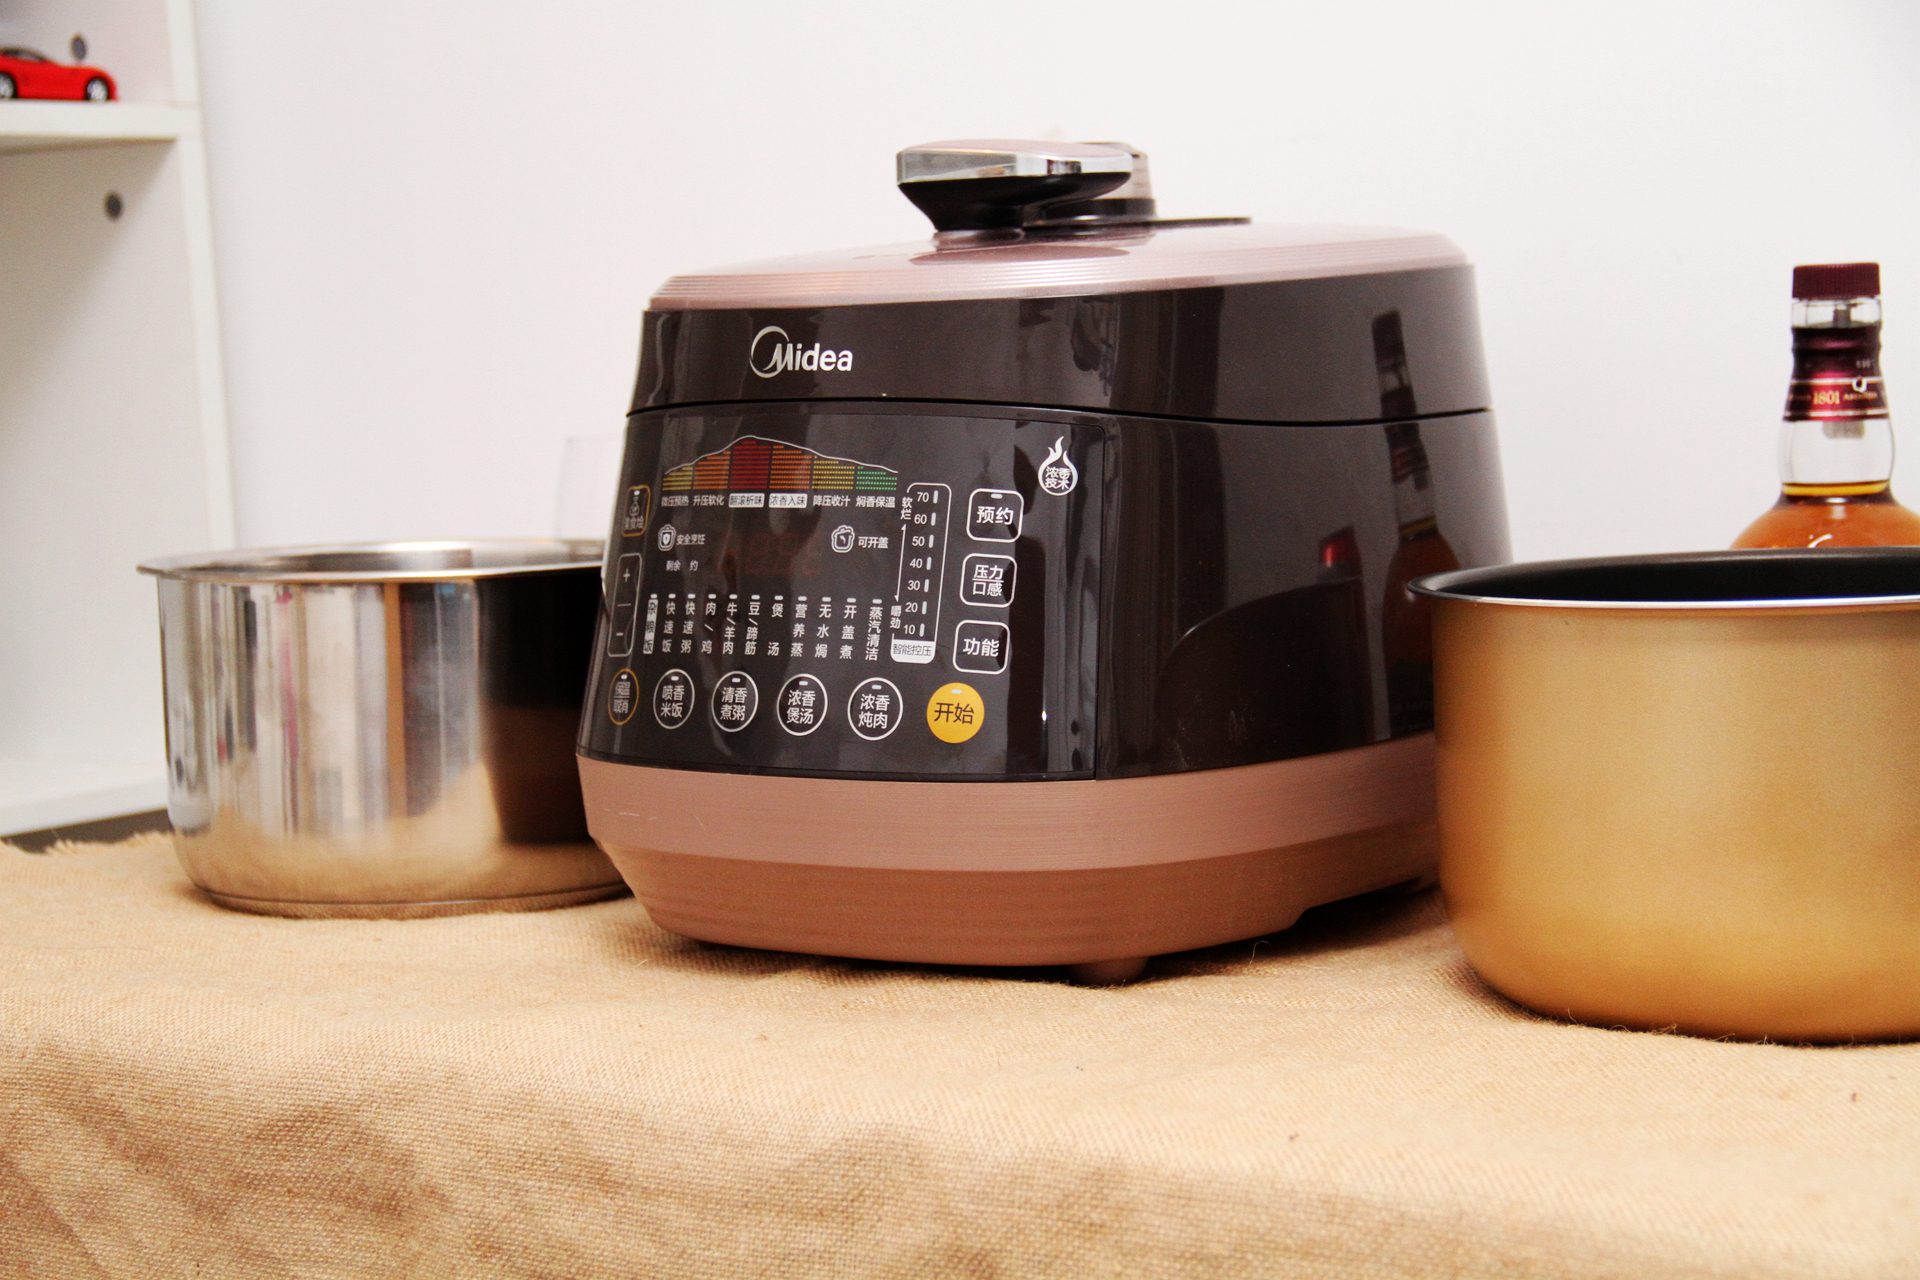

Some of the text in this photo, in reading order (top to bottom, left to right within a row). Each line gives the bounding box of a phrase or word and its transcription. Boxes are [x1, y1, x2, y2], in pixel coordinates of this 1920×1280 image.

[749, 325, 853, 378] Midea
[1813, 389, 1840, 405] 1801
[1045, 477, 1070, 490] 技术
[693, 494, 725, 507] 升压软化
[769, 494, 806, 507] 浓香入味
[812, 495, 850, 507] 降压收汁
[855, 496, 896, 508] 焖香保温
[916, 492, 930, 503] 70
[914, 514, 927, 525] 60
[976, 506, 1014, 526] 预约
[858, 536, 889, 549] 可开盖
[912, 536, 925, 547] 50
[909, 558, 923, 569] 40
[973, 565, 1004, 580] 压力
[907, 580, 921, 591] 30
[972, 581, 1003, 597] 口感
[905, 602, 918, 613] 20
[681, 602, 696, 654] 快速粥
[791, 604, 808, 658] 营养蒸
[840, 605, 857, 660] 开盖煮
[865, 606, 883, 662] 蒸汽清洁
[903, 624, 916, 635] 10
[893, 643, 932, 656] 智能控压
[962, 638, 1000, 658] 功能
[662, 685, 685, 700] 喷香
[722, 687, 747, 704] 清香
[788, 690, 816, 707] 浓香
[660, 702, 683, 718] 米饭
[860, 694, 890, 711] 浓香
[720, 704, 746, 721] 煮粥
[787, 707, 814, 725] 煲汤
[858, 711, 888, 729] 炖肉
[934, 702, 975, 725] 开始
